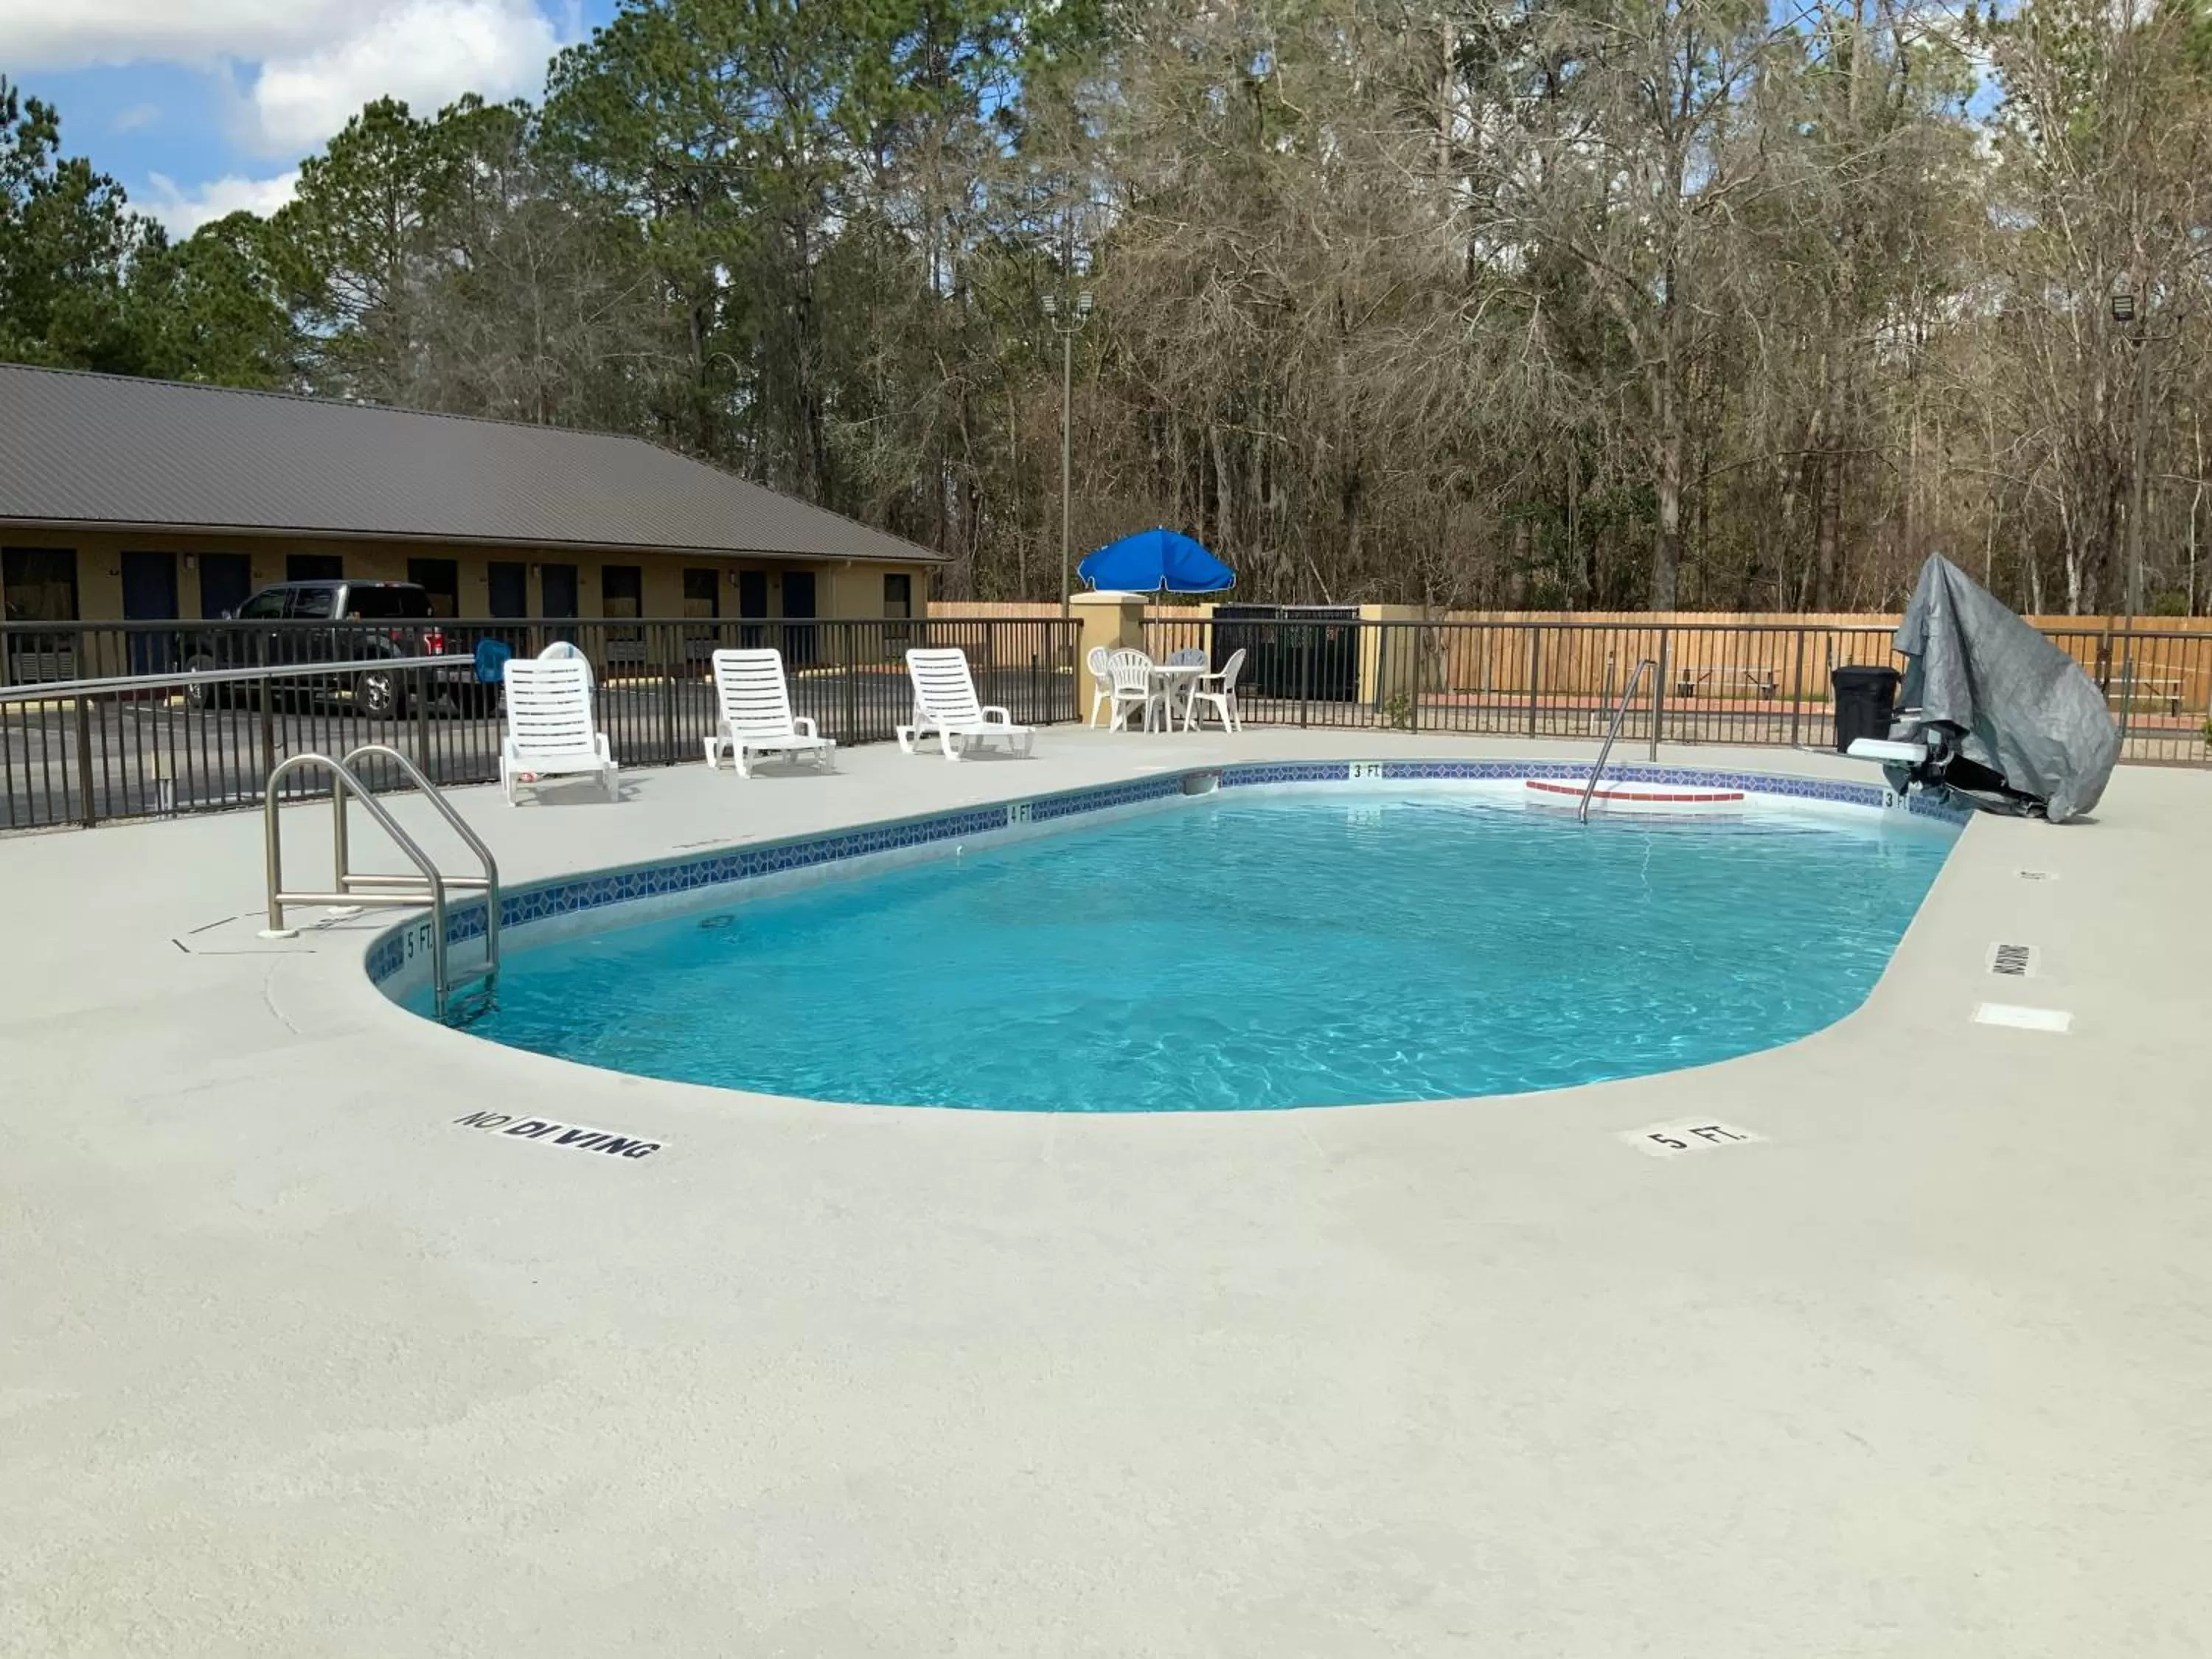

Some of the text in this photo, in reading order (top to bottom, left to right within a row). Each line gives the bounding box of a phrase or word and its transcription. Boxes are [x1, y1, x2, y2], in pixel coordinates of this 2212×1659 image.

[1354, 765, 1361, 778] 3
[1886, 792, 1893, 807] 3
[408, 931, 414, 959] 5
[453, 1110, 661, 1160] NO DIVING
[1647, 1125, 1748, 1150] 5 FT.
